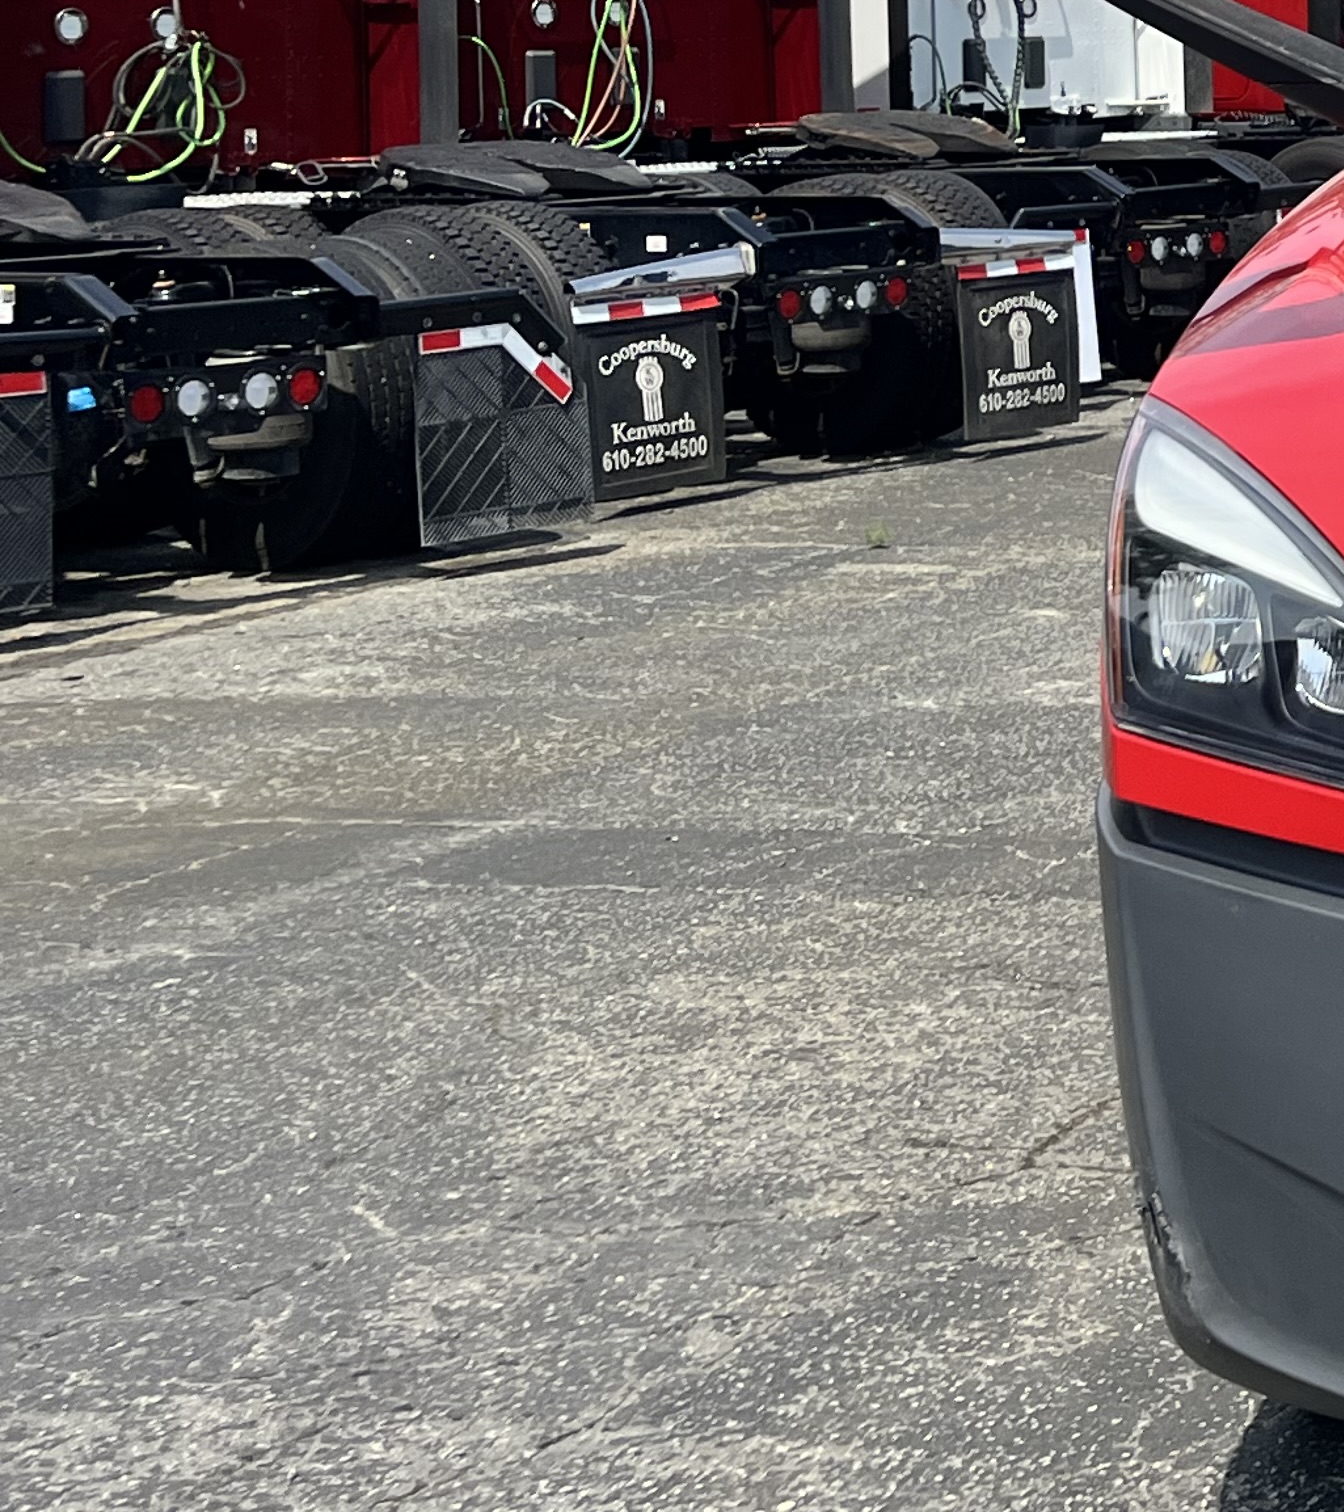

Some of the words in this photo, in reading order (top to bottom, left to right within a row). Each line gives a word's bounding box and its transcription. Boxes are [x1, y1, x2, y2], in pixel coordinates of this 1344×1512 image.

[978, 291, 1059, 327] Coopersburg
[598, 334, 697, 376] Coopersburg
[987, 361, 1057, 389] Kenworth
[979, 383, 1065, 413] 610-282-4500
[611, 411, 697, 445] Kenworth
[602, 435, 708, 472] 610-282-4500
